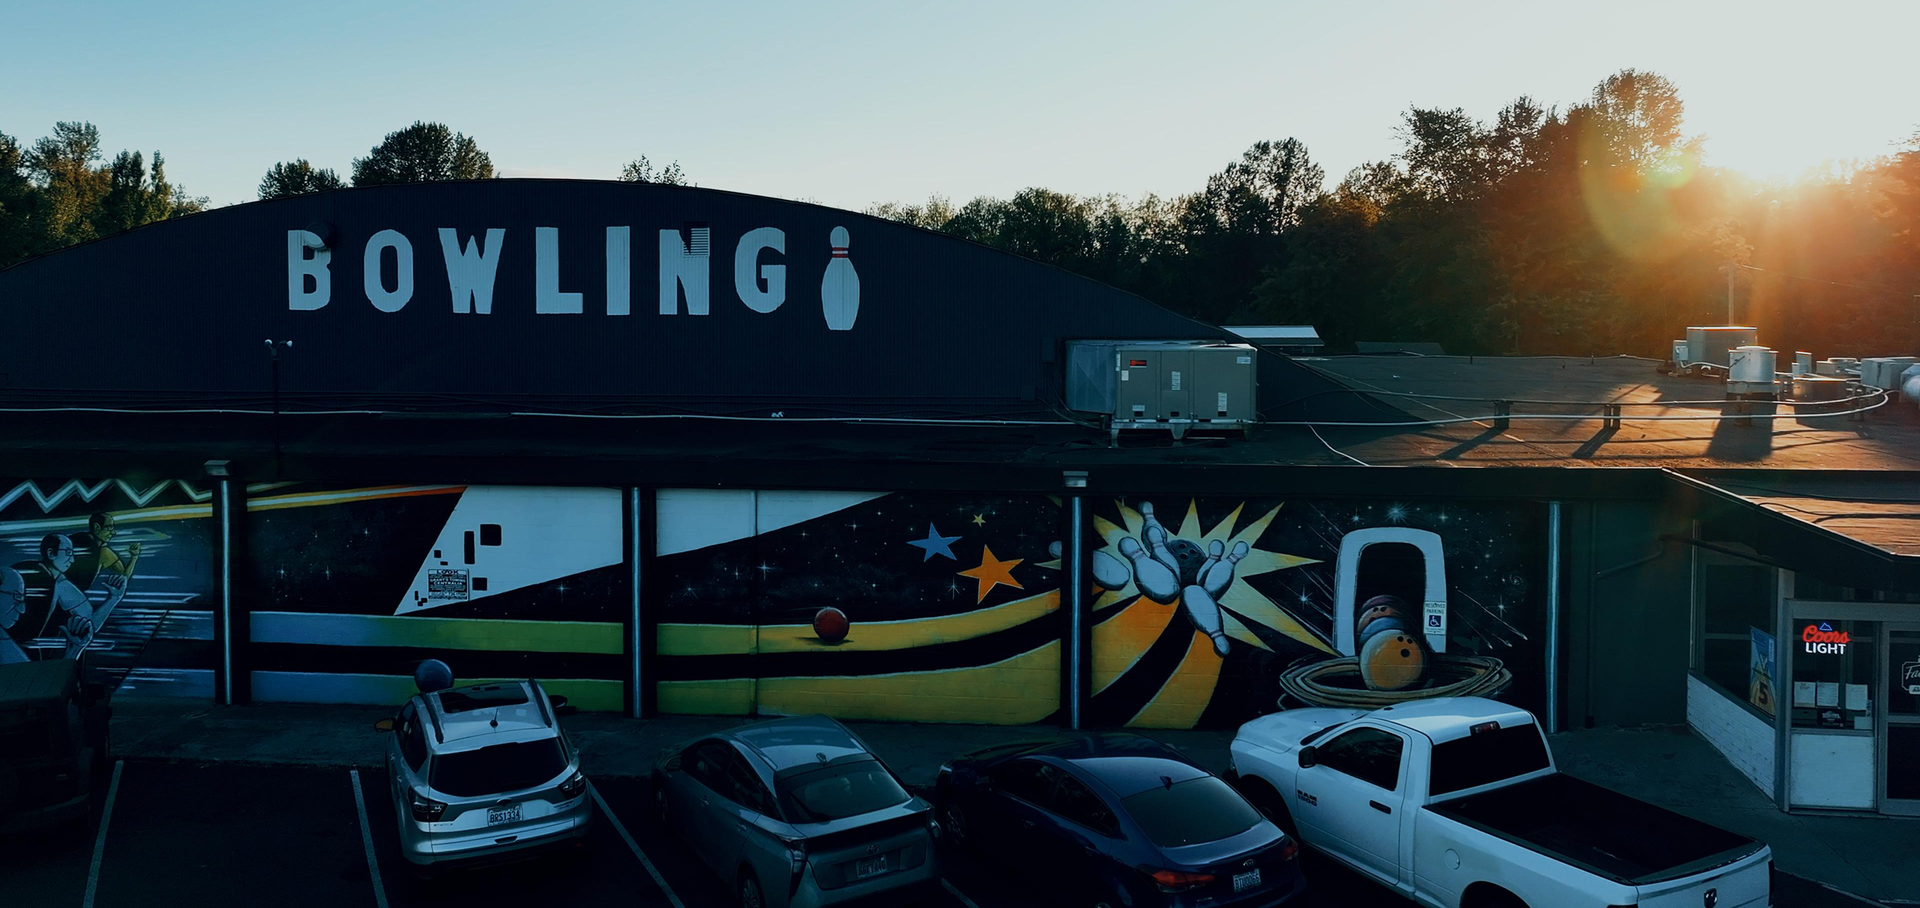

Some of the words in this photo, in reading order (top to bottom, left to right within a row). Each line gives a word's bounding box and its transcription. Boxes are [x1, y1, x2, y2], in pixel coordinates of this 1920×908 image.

[288, 225, 787, 315] BOWLING
[1802, 624, 1851, 643] Coors
[1805, 642, 1847, 655] LIGHT
[1297, 789, 1317, 802] RAM
